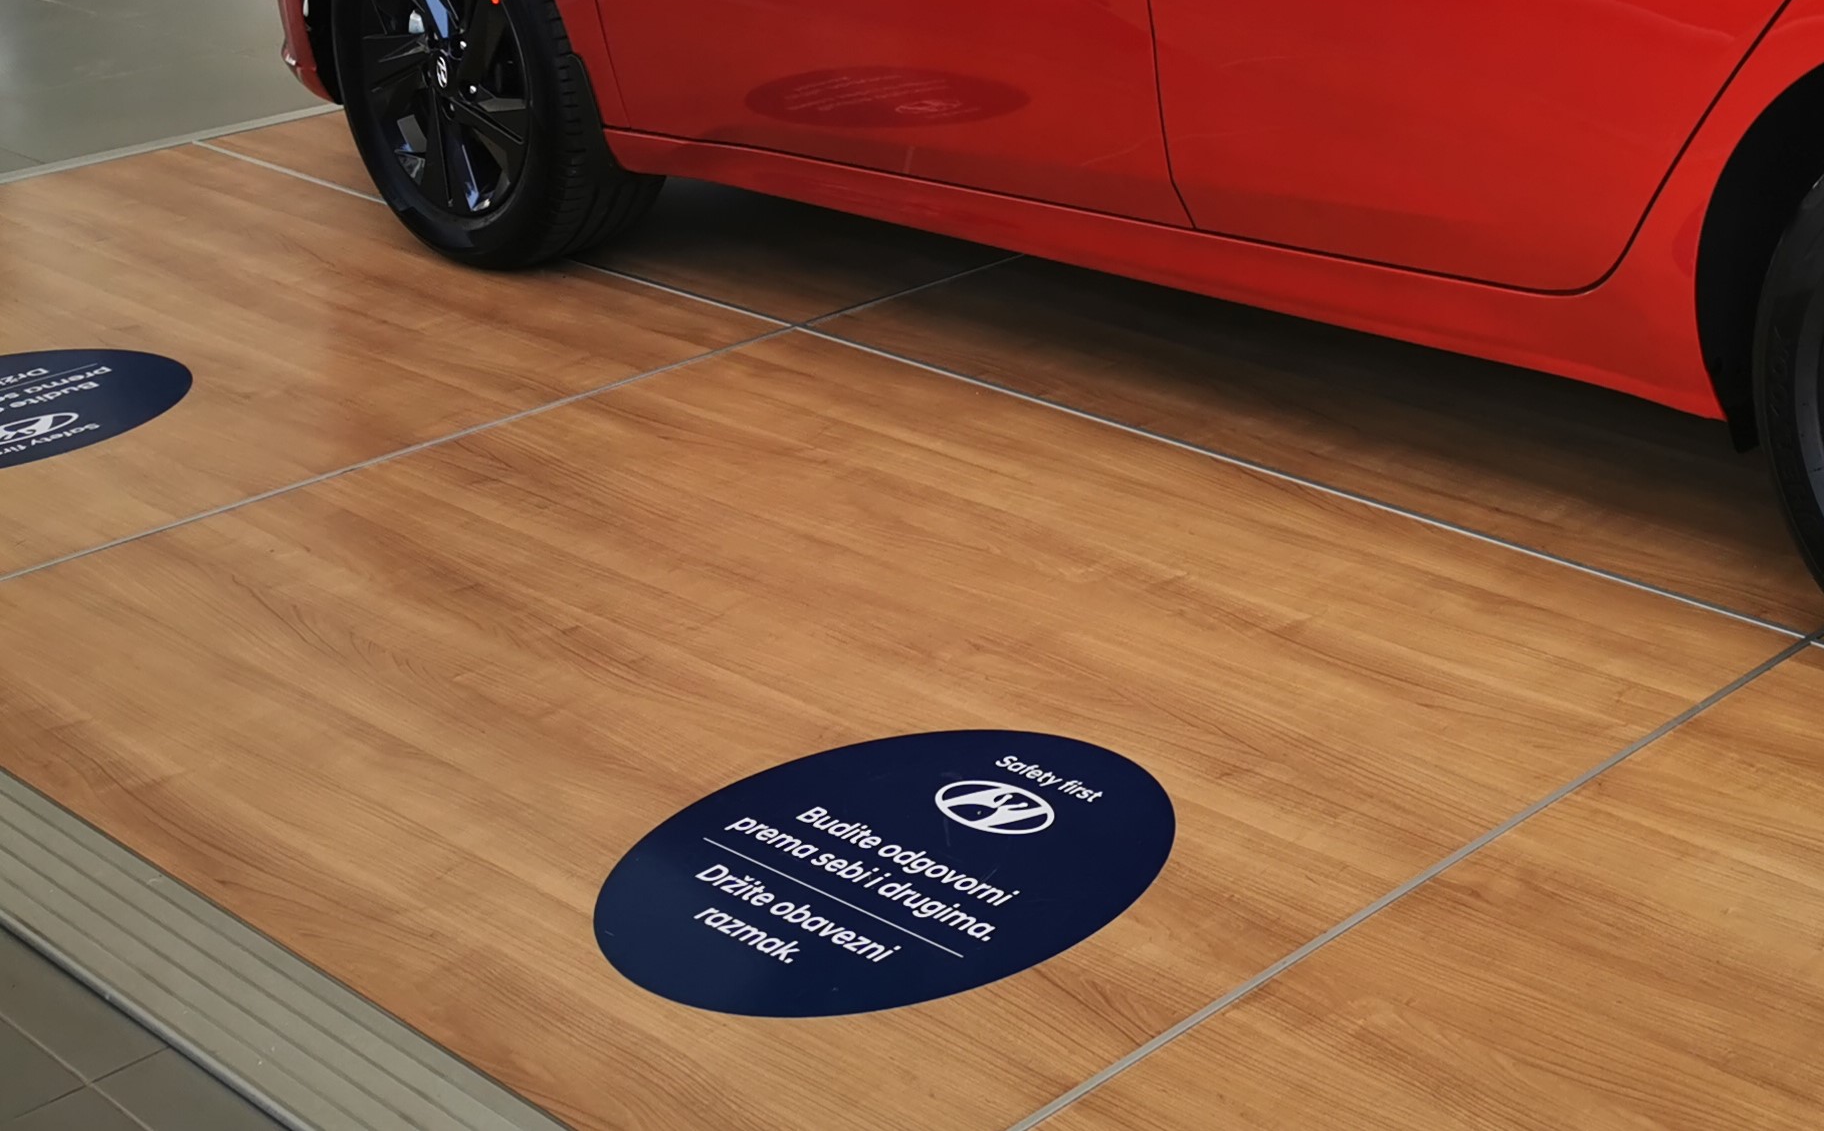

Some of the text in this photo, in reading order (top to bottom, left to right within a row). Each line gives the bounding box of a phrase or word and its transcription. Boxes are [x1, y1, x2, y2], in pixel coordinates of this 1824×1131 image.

[995, 754, 1103, 804] Safety first
[724, 816, 997, 943] prema sebi i drugima.
[795, 805, 1020, 908] Budite odgovorni
[693, 906, 800, 965] razmak.
[694, 863, 903, 964] Držite obavezni
